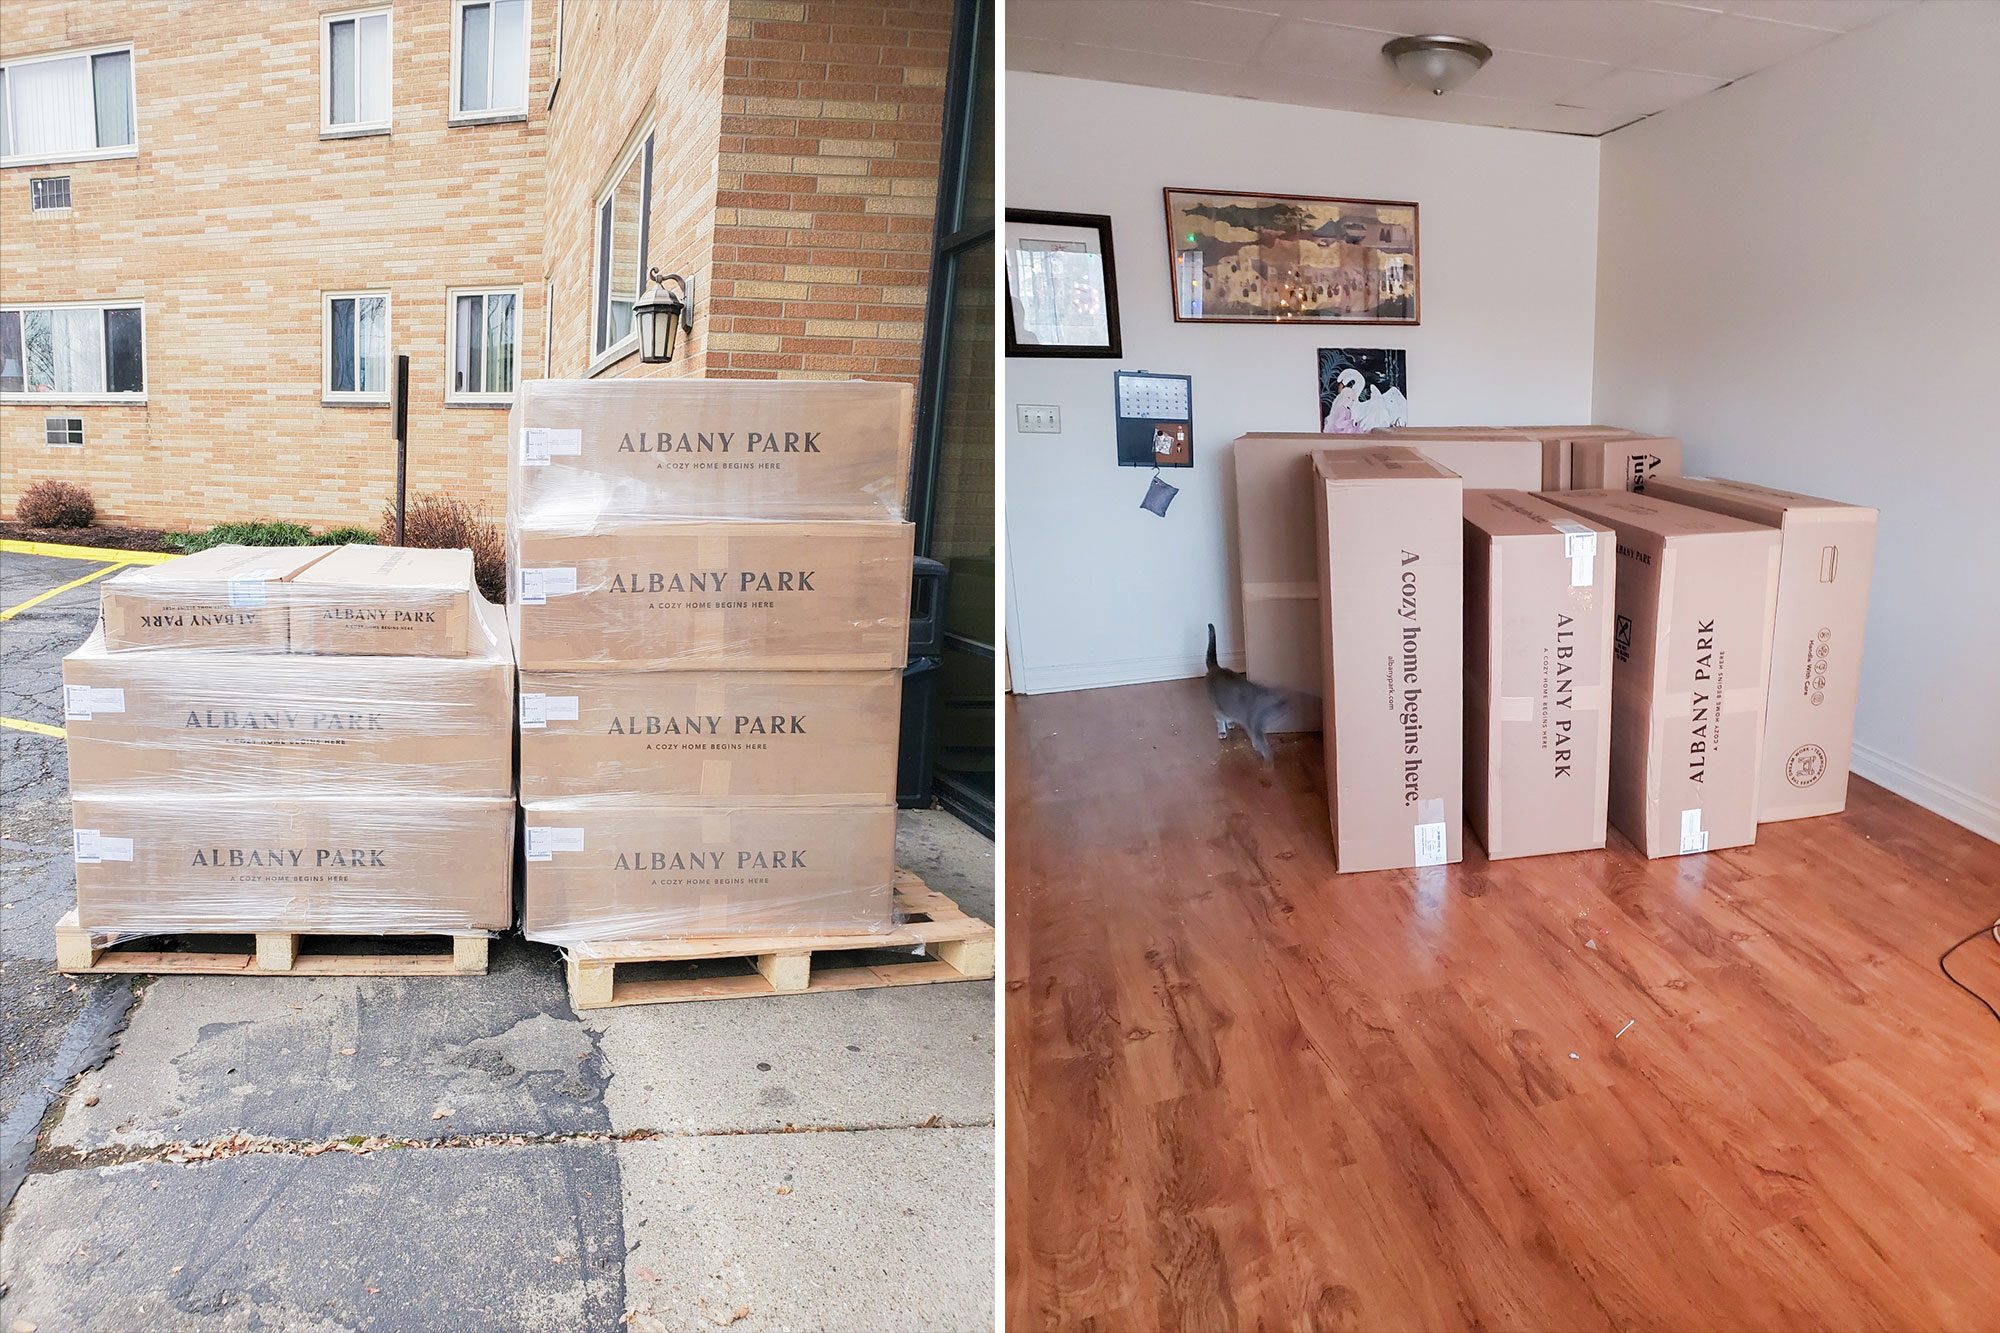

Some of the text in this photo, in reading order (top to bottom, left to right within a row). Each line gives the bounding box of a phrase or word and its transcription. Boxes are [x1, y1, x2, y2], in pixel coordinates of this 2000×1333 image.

[617, 431, 822, 453] ALBANY PARK
[758, 462, 781, 470] HERE
[1648, 454, 1661, 470] A
[1635, 550, 1652, 566] PARK
[608, 571, 816, 594] ALBANY PARK
[323, 608, 436, 623] ALBANY PARK
[658, 602, 683, 610] COZY
[686, 602, 712, 610] HOME
[141, 614, 256, 628] ALBANY PARK
[1387, 655, 1395, 711] albanypark.com
[1397, 549, 1423, 807] A cozy home begins here.
[1555, 613, 1574, 778] ALBANY PARK
[1689, 619, 1714, 784] ALBANY PARK
[185, 710, 384, 730] ALBANY PARK
[607, 714, 807, 736] ALBANY PARK
[191, 849, 386, 867] ALBANY PARK
[614, 850, 807, 871] ALBANY PARK
